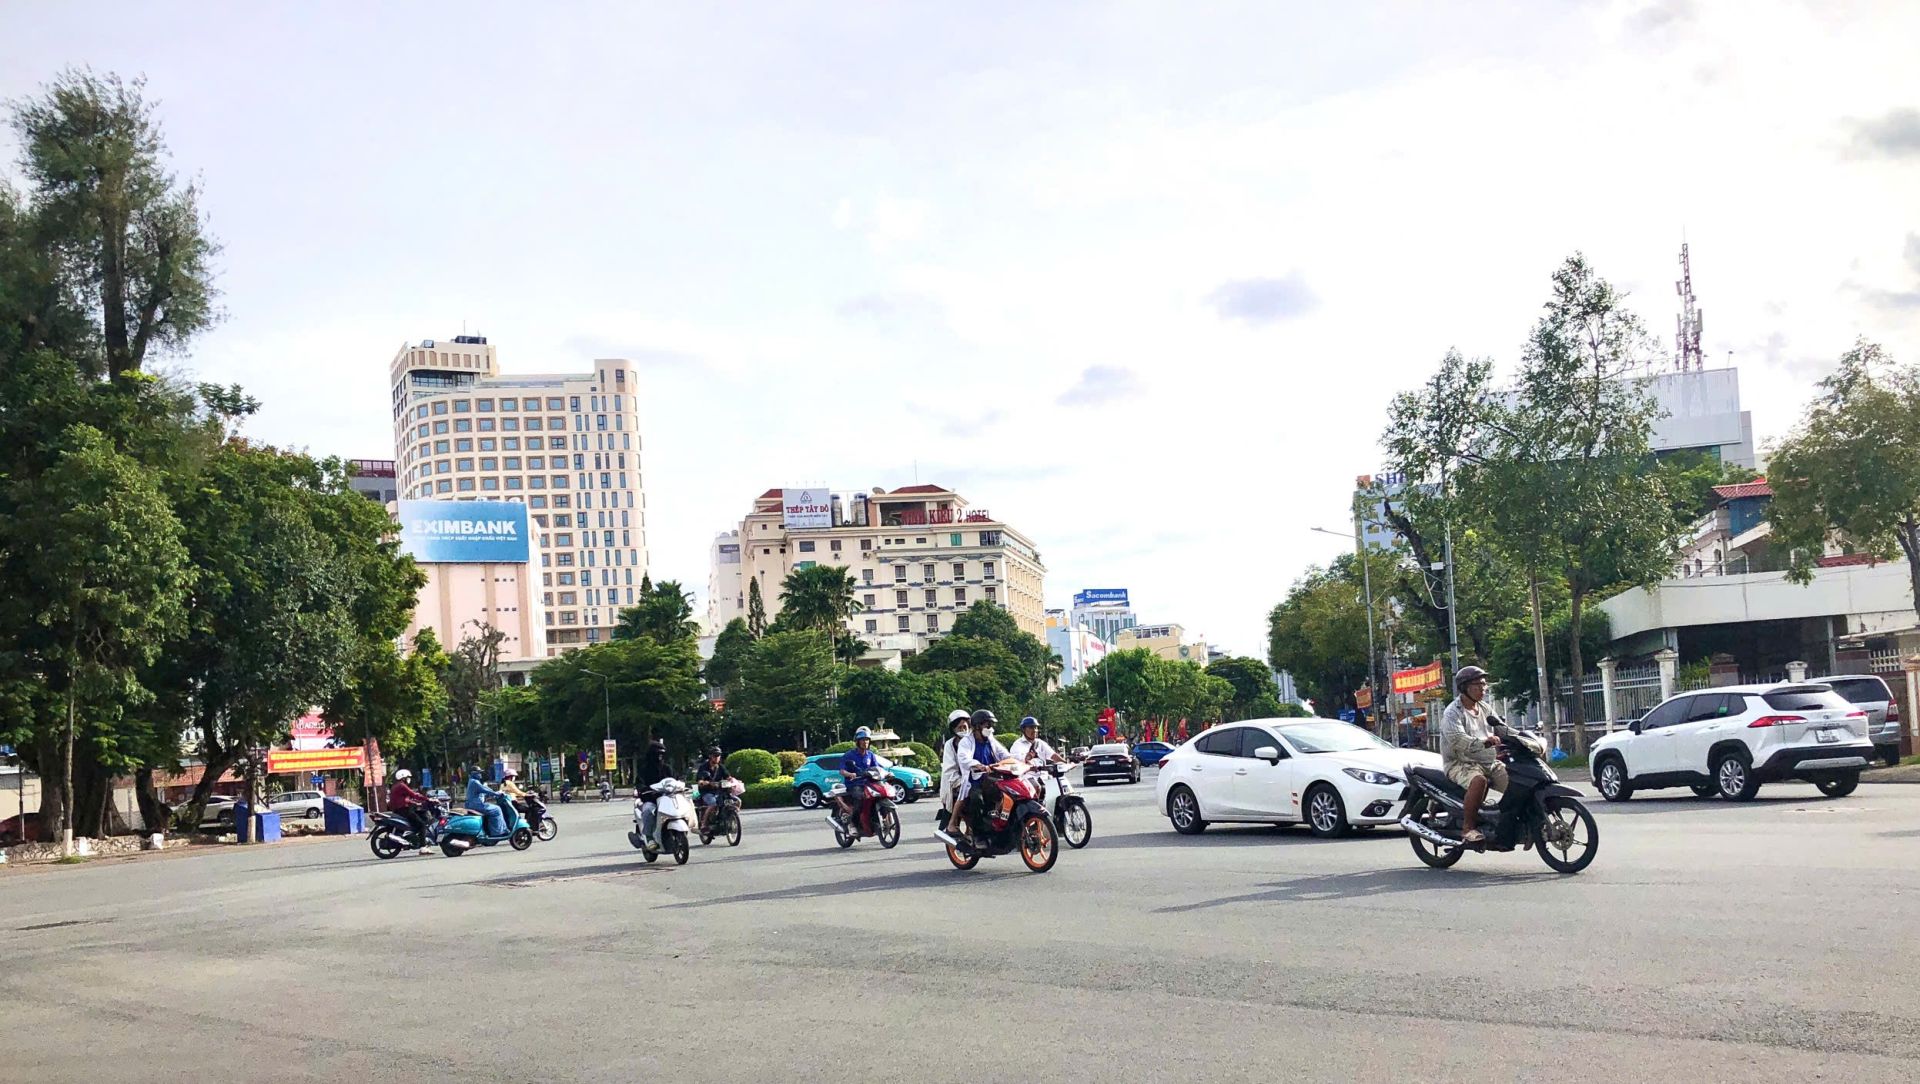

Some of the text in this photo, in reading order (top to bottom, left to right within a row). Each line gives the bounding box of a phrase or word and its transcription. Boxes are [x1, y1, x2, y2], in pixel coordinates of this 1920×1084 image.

[957, 508, 962, 523] 2
[966, 510, 989, 522] HOTEL
[412, 520, 517, 535] EXIMBANK
[1086, 591, 1126, 599] Sacombank
